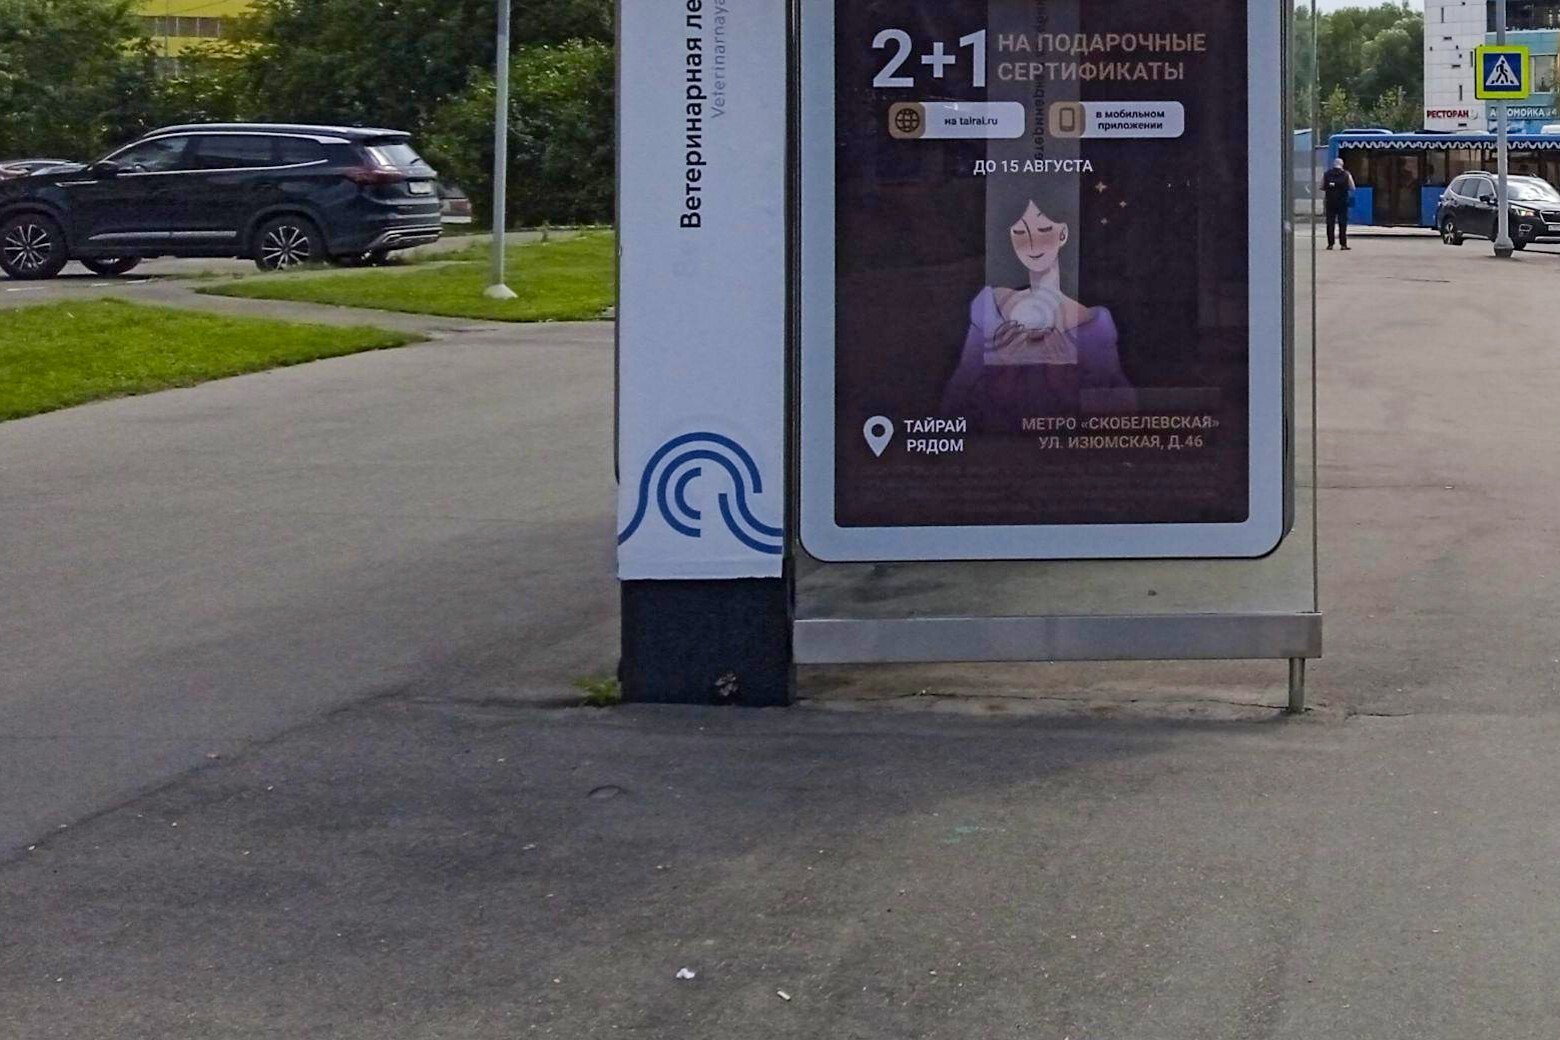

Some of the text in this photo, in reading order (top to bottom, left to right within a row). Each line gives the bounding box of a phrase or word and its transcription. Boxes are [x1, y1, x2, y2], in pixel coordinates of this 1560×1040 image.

[998, 33, 1206, 54] НА ПОДАРОЧНЫЕ
[872, 28, 987, 88] 2+1
[997, 62, 1184, 81] СЕРТИФИКАТЫ
[1106, 109, 1165, 120] мобильном
[1426, 110, 1469, 119] РЕСТОРАН
[1489, 107, 1545, 117] АОМОЙКА
[945, 117, 957, 126] на
[1098, 121, 1163, 131] приложении
[680, 37, 708, 229] Ветеринарная
[973, 159, 1093, 176] ДО 15 АВГУСТА
[904, 417, 967, 433] ТАЙРАЙ
[1022, 416, 1220, 431] МЕТРО «СКОБЕЛЕВСКАЯ»
[906, 439, 964, 454] РЯДОМ
[1039, 435, 1204, 450] УЛ. ИЗЮМСКАЯ, Д.46
